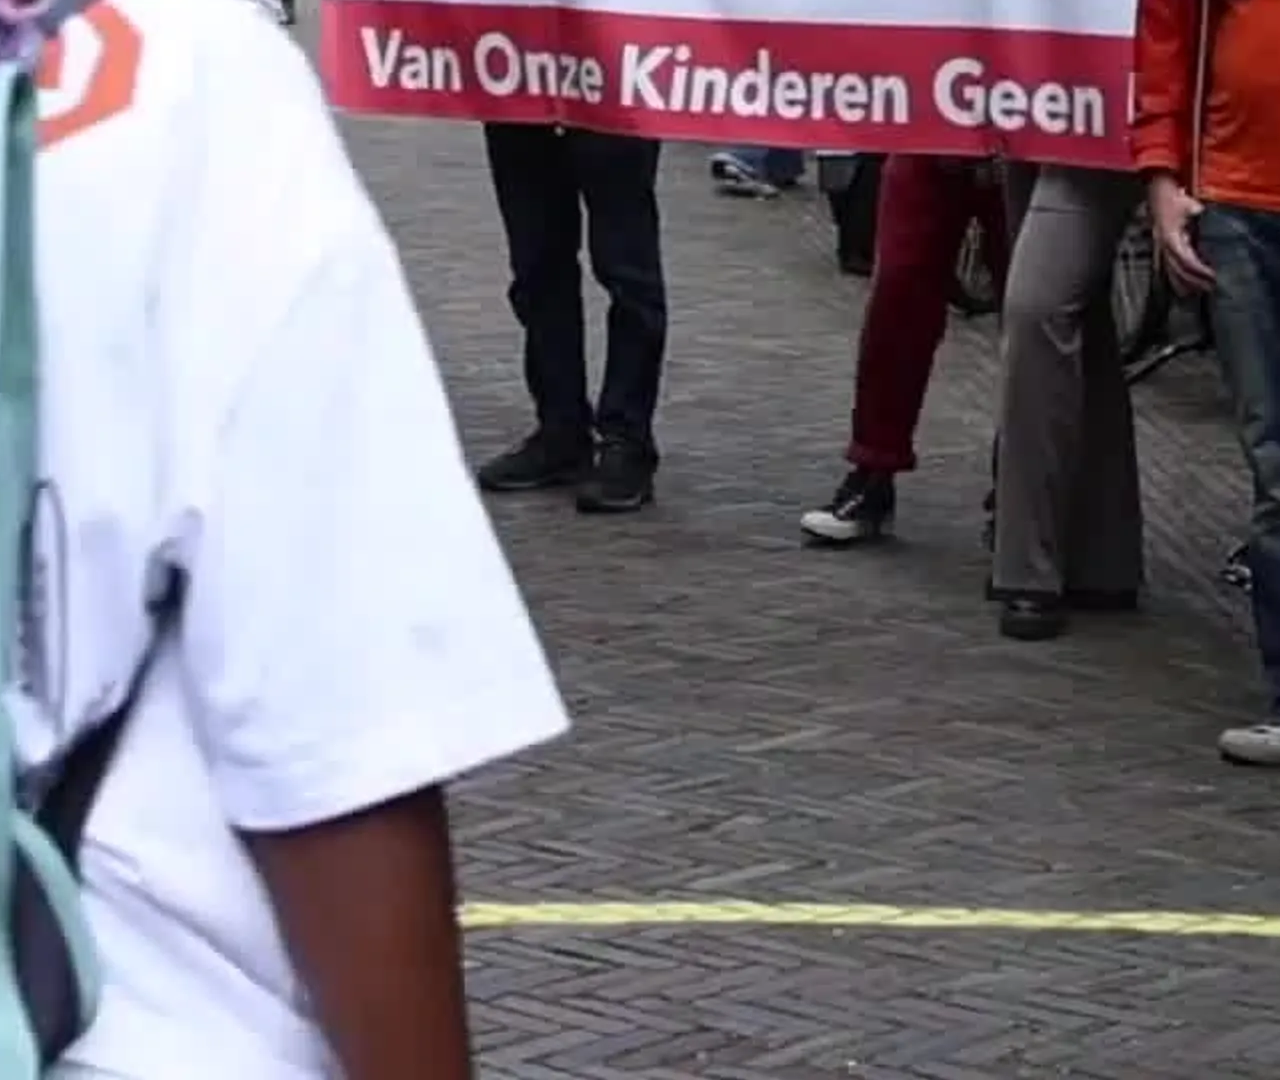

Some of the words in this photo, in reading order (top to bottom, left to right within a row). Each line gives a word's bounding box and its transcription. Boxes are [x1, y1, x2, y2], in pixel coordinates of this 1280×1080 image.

[361, 28, 461, 95] Van
[474, 32, 603, 104] Onze
[620, 44, 909, 126] Kinderen
[934, 59, 1105, 137] Geen
